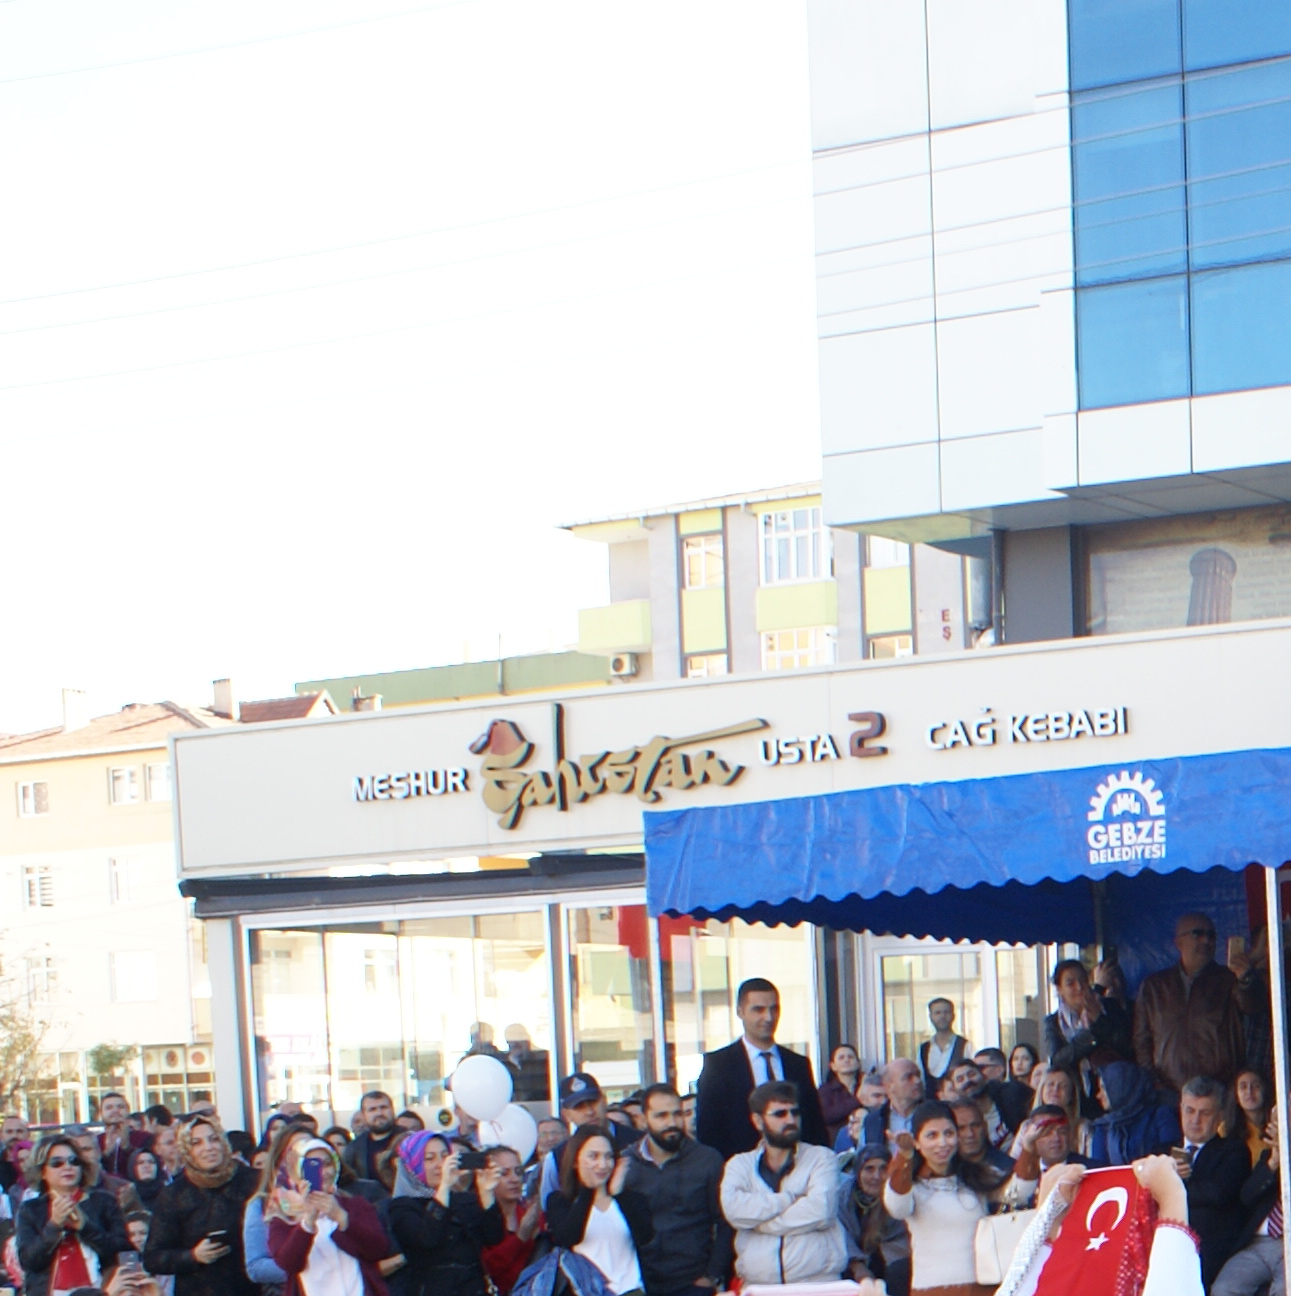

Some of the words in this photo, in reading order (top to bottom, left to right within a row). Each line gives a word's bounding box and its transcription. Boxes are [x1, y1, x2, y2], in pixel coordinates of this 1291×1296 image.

[758, 733, 842, 767] USTA
[847, 711, 889, 758] 2
[926, 705, 997, 751] CAĞ
[1008, 706, 1128, 743] KEBABI
[1087, 819, 1167, 850] GEBZE
